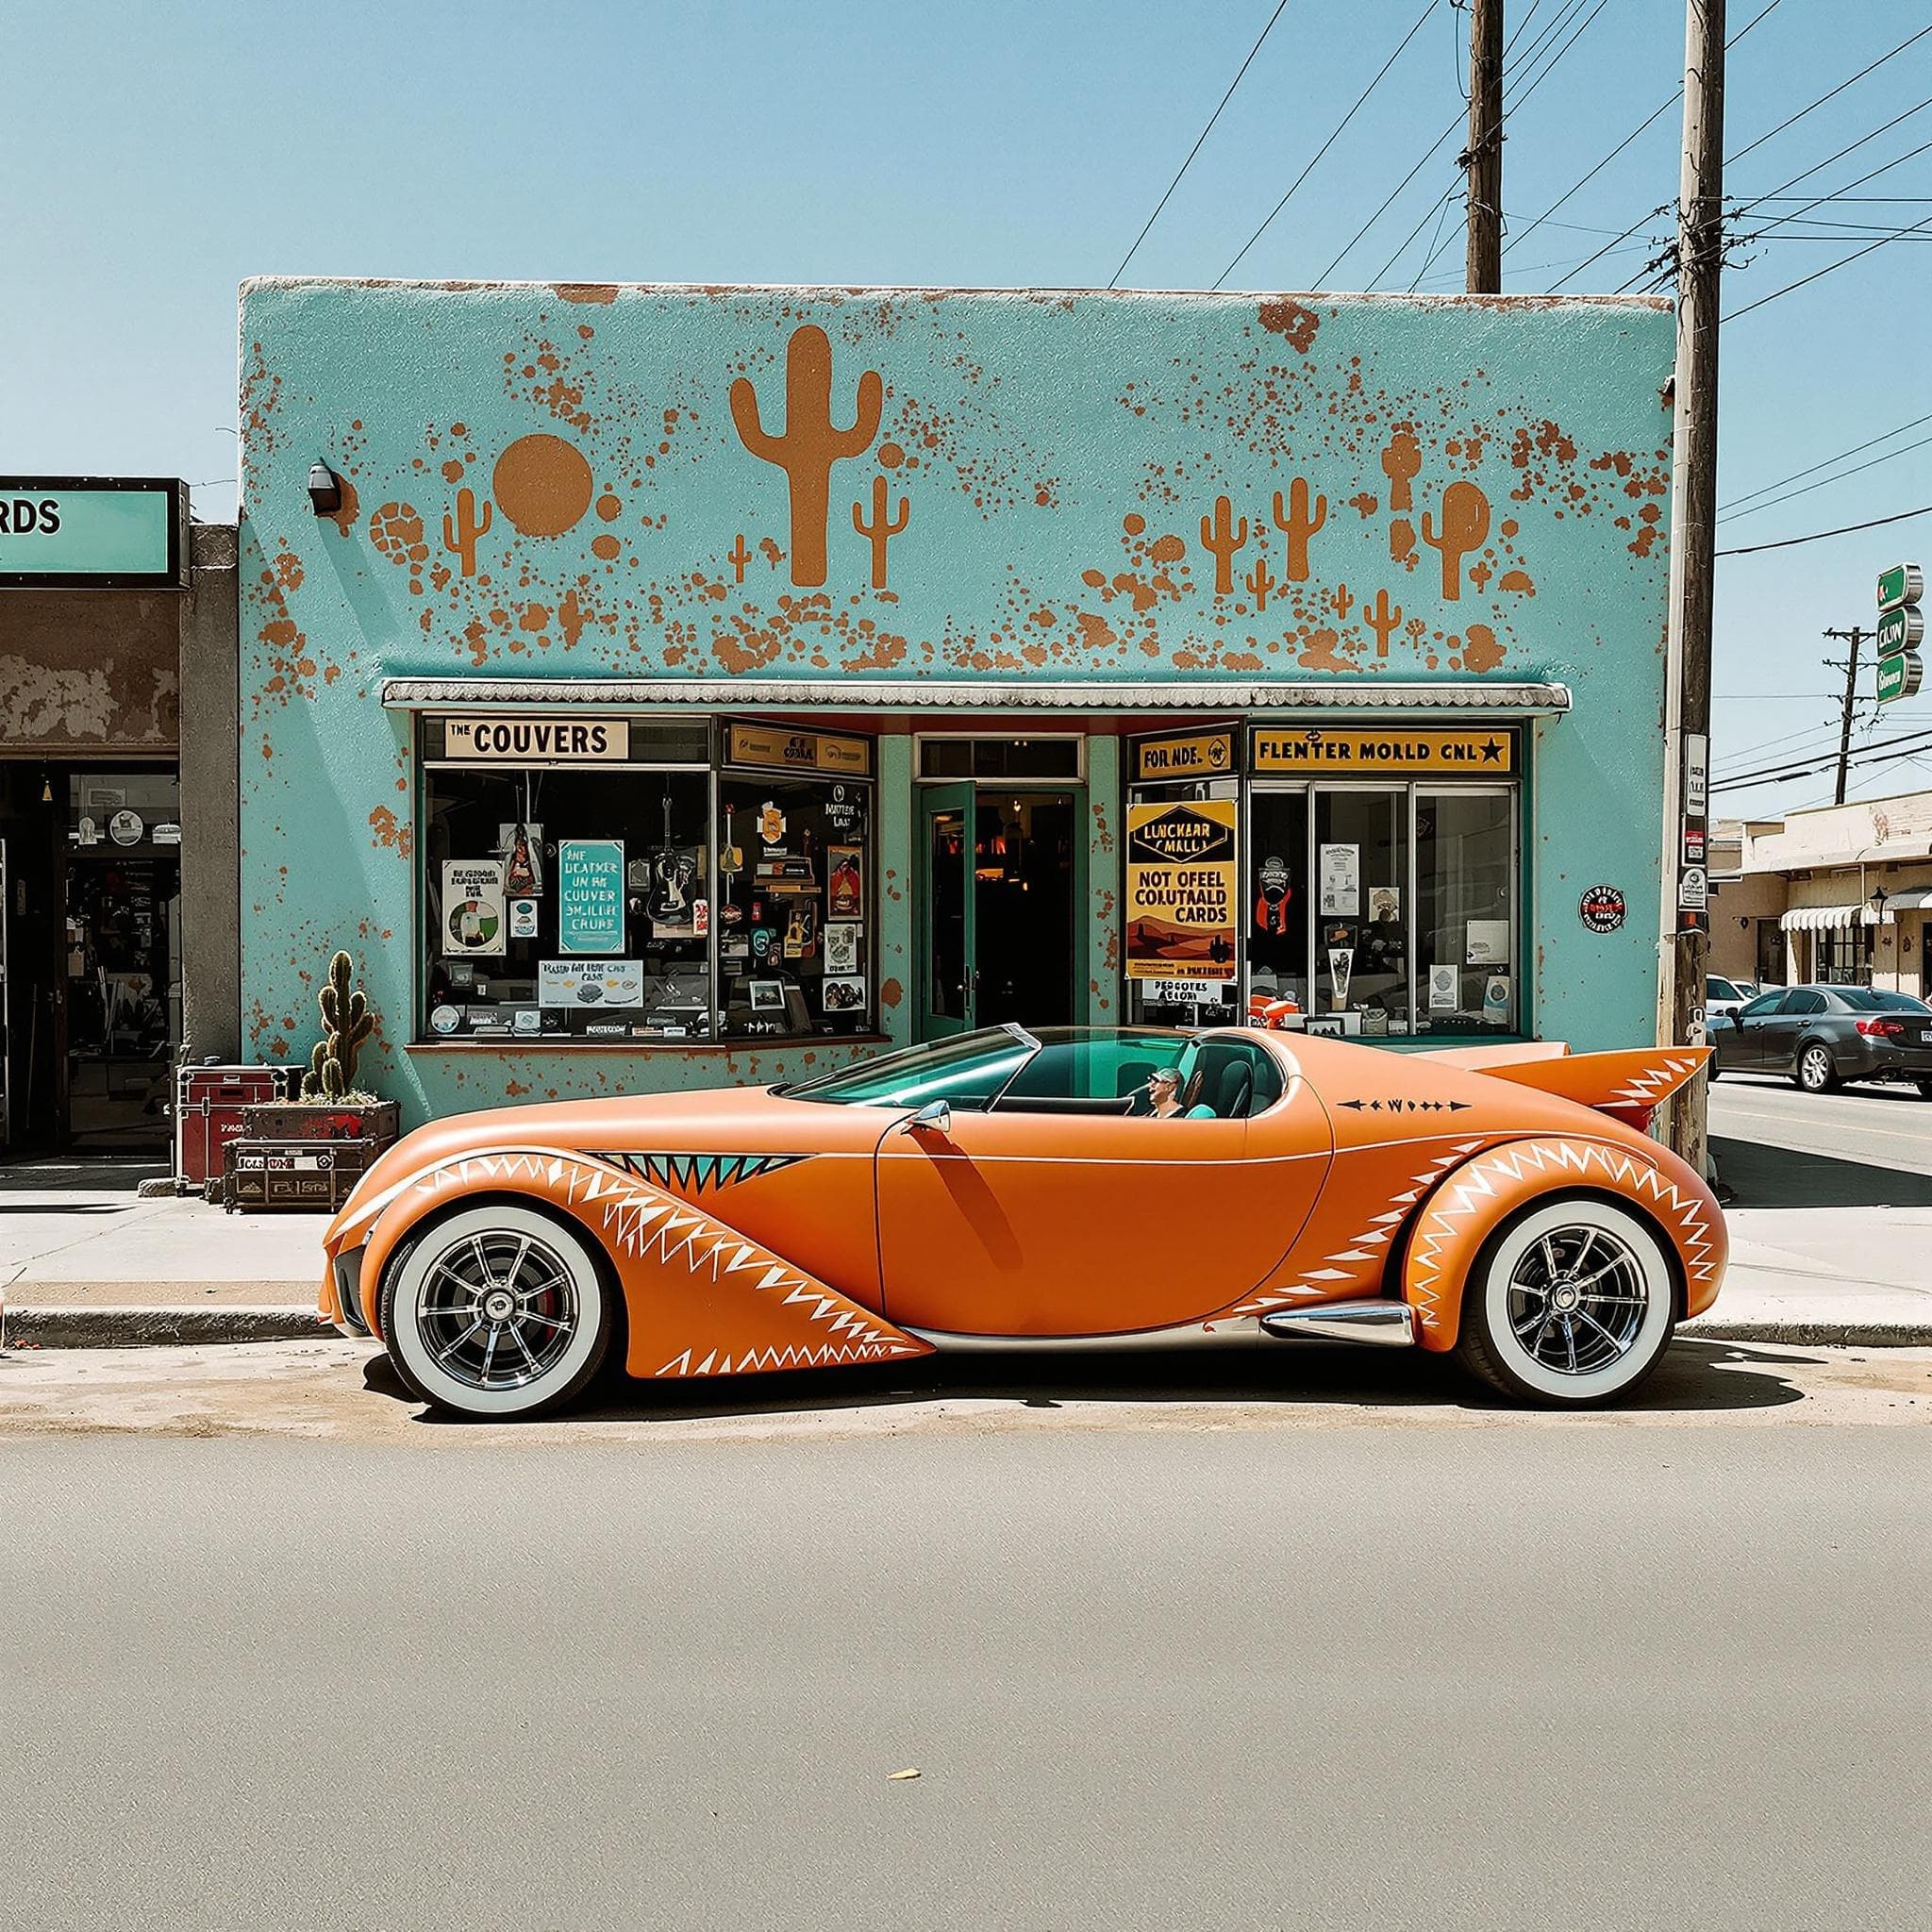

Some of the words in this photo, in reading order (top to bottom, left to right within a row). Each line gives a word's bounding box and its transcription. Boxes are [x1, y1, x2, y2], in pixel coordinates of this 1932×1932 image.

[451, 724, 471, 736] THE
[475, 724, 608, 753] COUVERS
[1259, 741, 1352, 759] FLENTER
[1139, 872, 1172, 887] NOT
[1177, 872, 1225, 887] OFEEL
[1175, 907, 1227, 922] CARDS
